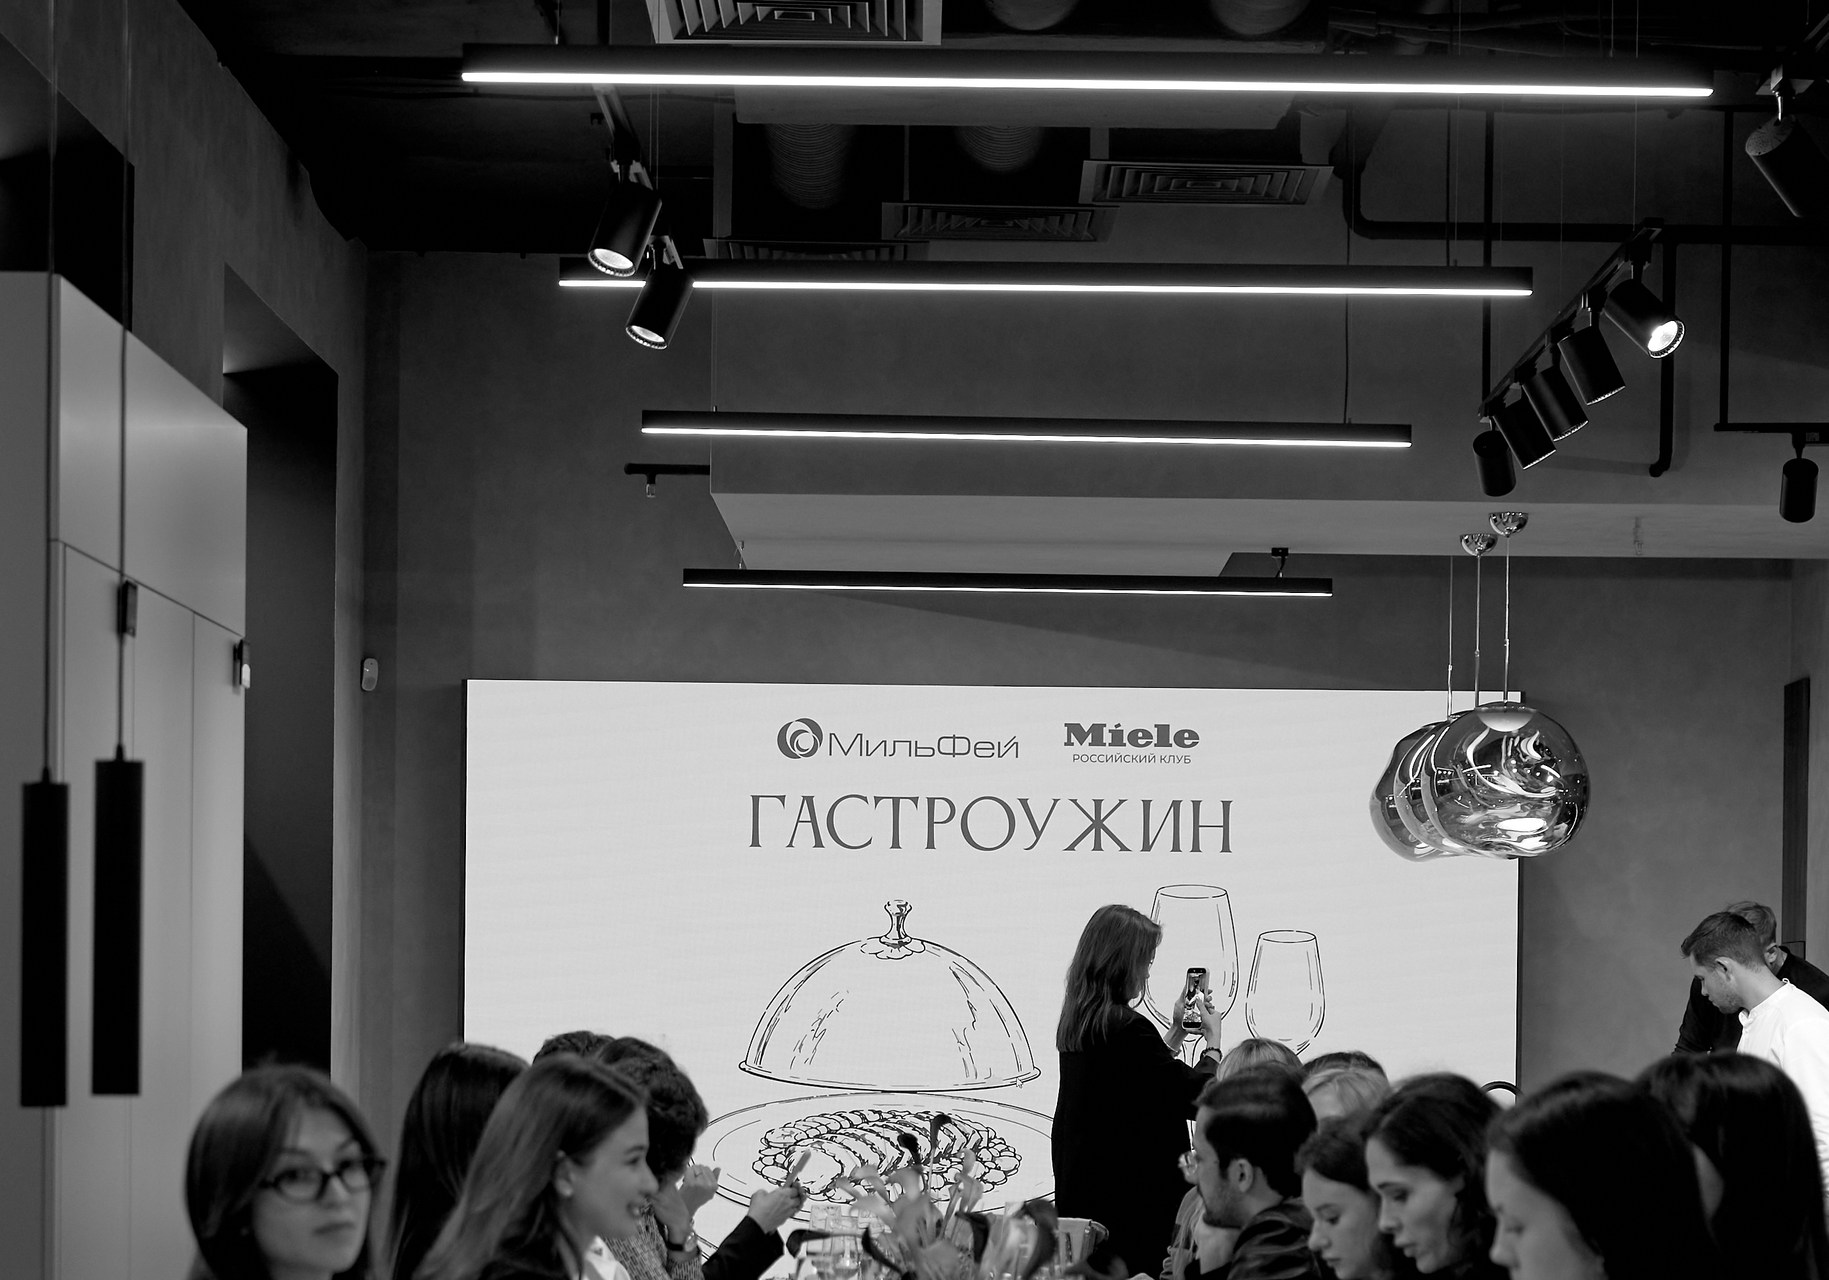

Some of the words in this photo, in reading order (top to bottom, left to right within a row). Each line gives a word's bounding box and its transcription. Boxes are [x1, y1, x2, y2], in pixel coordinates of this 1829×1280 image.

[828, 732, 1019, 759] МильФей
[1064, 722, 1200, 749] Miele
[1072, 752, 1156, 764] РОССИЙСКИЙ
[1159, 754, 1192, 765] КЛУБ
[749, 793, 1233, 853] ГАСТРОУЖИН
